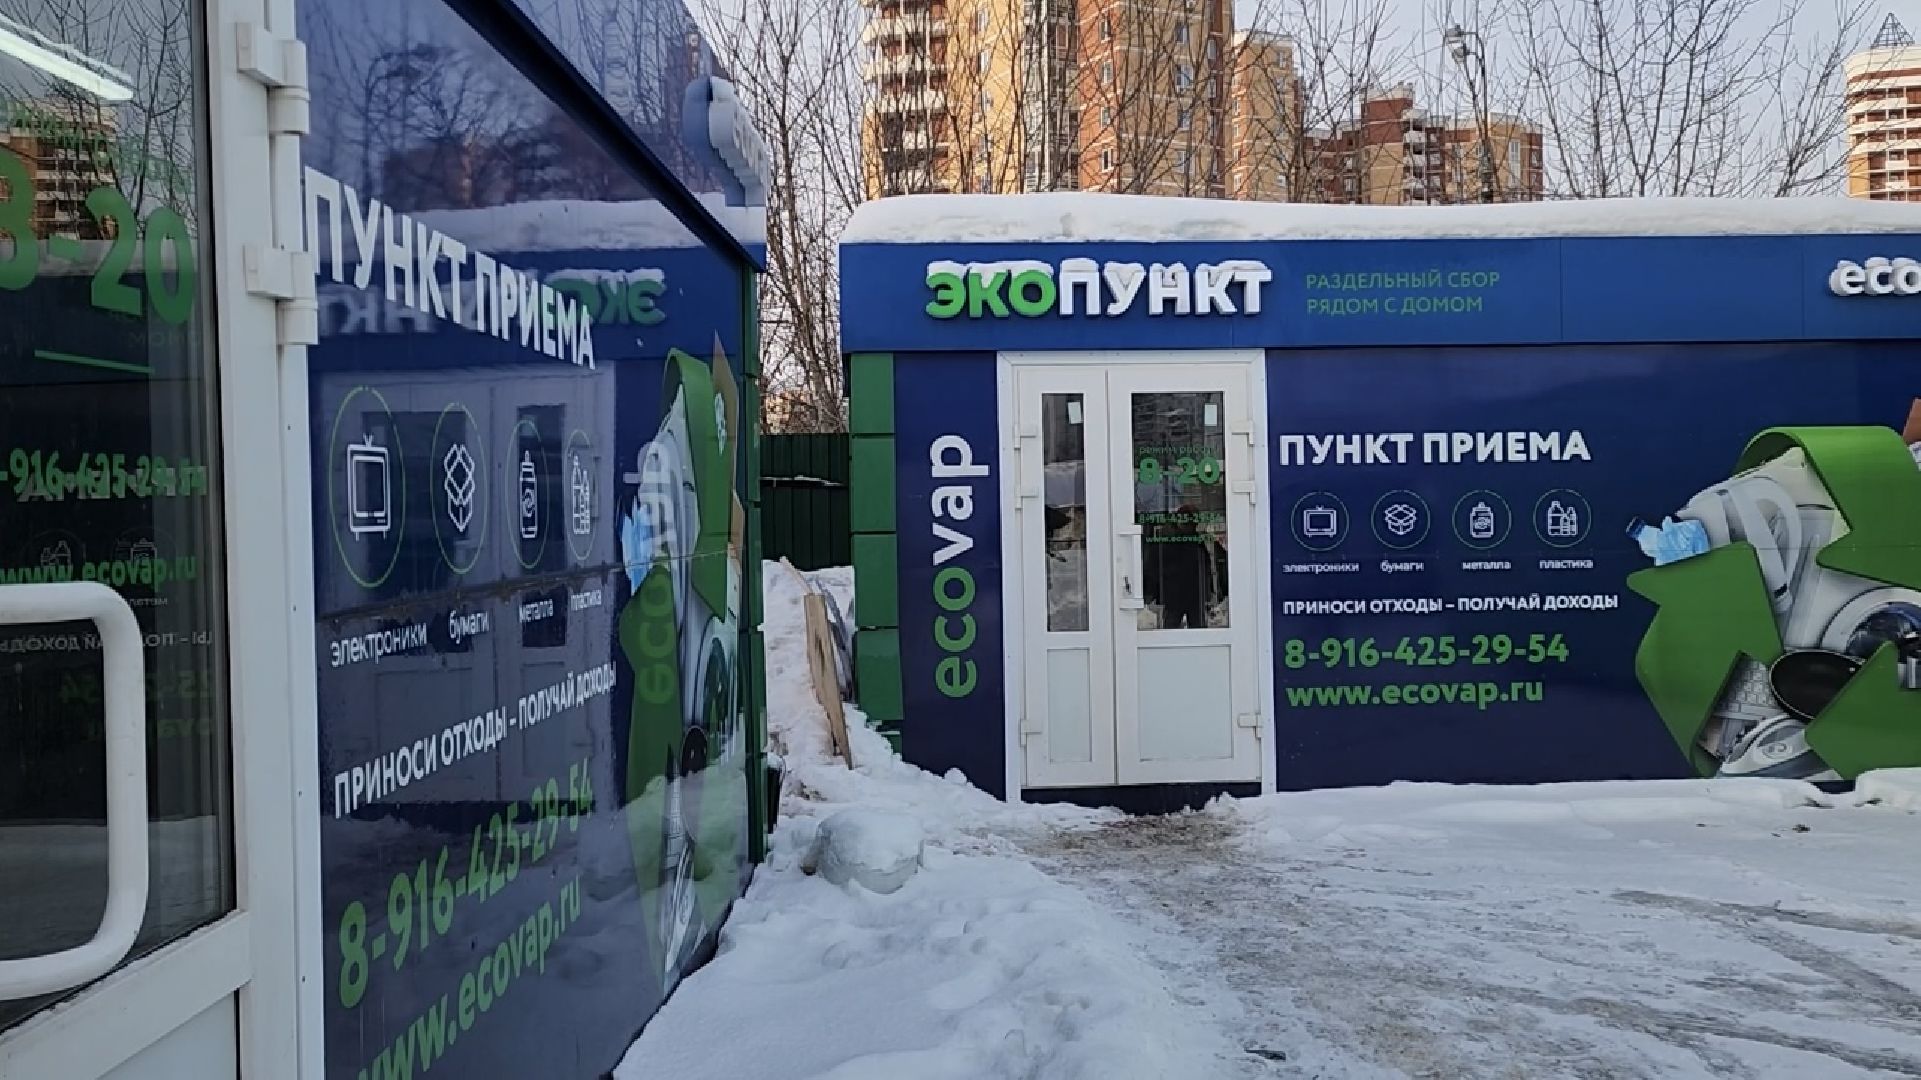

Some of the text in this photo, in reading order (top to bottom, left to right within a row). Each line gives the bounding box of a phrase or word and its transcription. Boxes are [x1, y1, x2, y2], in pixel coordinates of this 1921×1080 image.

[304, 166, 595, 369] ПУНКТ ПРИЕМА
[1306, 269, 1500, 291] РАЗДЕЛЬНЫЙ СБОР
[926, 260, 1272, 318] ЭКОПУНКТ
[1308, 297, 1483, 316] РЯДОМ С ДОМОМ
[1279, 430, 1591, 466] ПУНКТ ПРИЕМА
[930, 434, 990, 698] ecovap
[1282, 562, 1359, 574] электроники
[1380, 560, 1424, 573] бумаги
[1462, 560, 1511, 570] металла
[1539, 559, 1593, 569] пластика
[519, 599, 553, 622] металла
[1283, 600, 1366, 615] ПРИНОСИ
[1370, 598, 1442, 615] ОТХОДЫ
[1458, 593, 1540, 611] ПОЛУЧАЙ
[1543, 595, 1618, 612] ДОХОДЫ
[449, 610, 489, 644] бумаги
[330, 622, 427, 667] электроники
[1284, 634, 1570, 668] 8-916-425-29-54
[1286, 682, 1543, 710] www.ecovap.ru
[334, 734, 438, 818] ПРИНОСИ
[440, 706, 508, 766] ОТХОДЫ
[519, 670, 575, 729] ПОЛУЧАЙ
[576, 661, 617, 707] ДОХОДЫ
[339, 757, 594, 1009] 8-916-425-29-54
